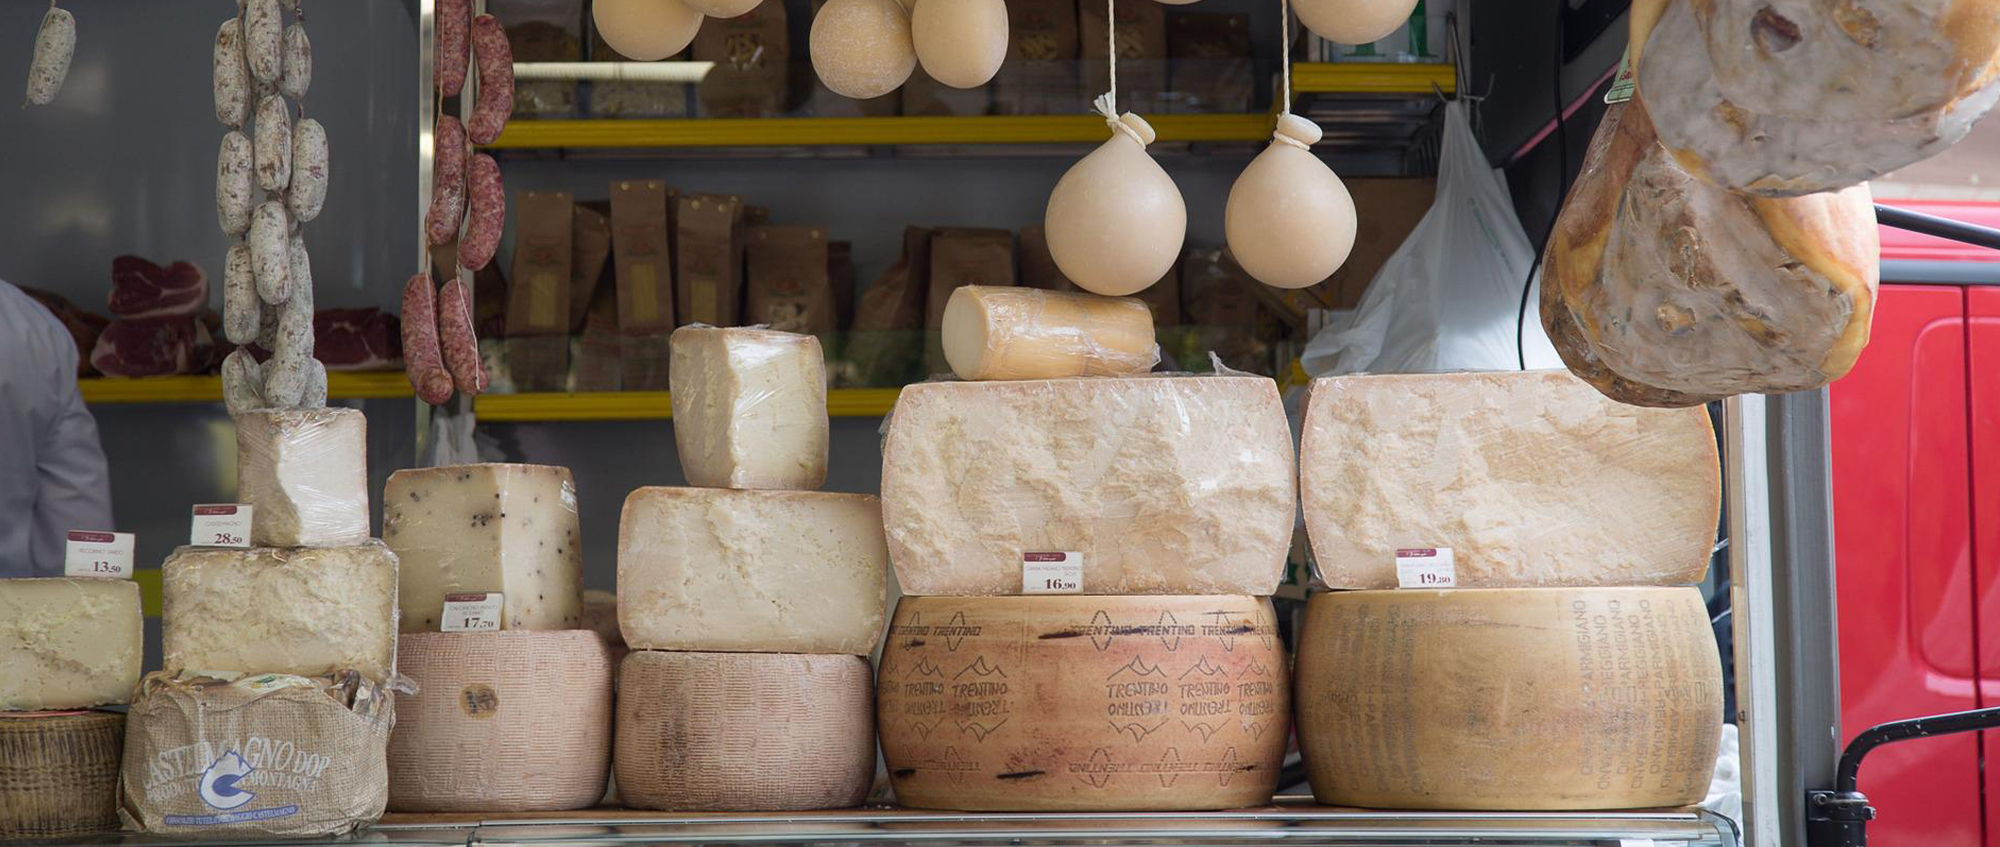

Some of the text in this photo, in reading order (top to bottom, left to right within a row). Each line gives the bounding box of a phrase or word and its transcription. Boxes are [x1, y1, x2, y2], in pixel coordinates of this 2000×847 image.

[933, 626, 982, 636] TRENTINO
[905, 681, 944, 698] TRENTINO
[952, 682, 1008, 698] TRENTINO
[1106, 682, 1168, 698] TRENTINO
[1177, 681, 1230, 699] TRENTINO
[1236, 681, 1273, 698] TRENTINO
[292, 750, 331, 778] DOP
